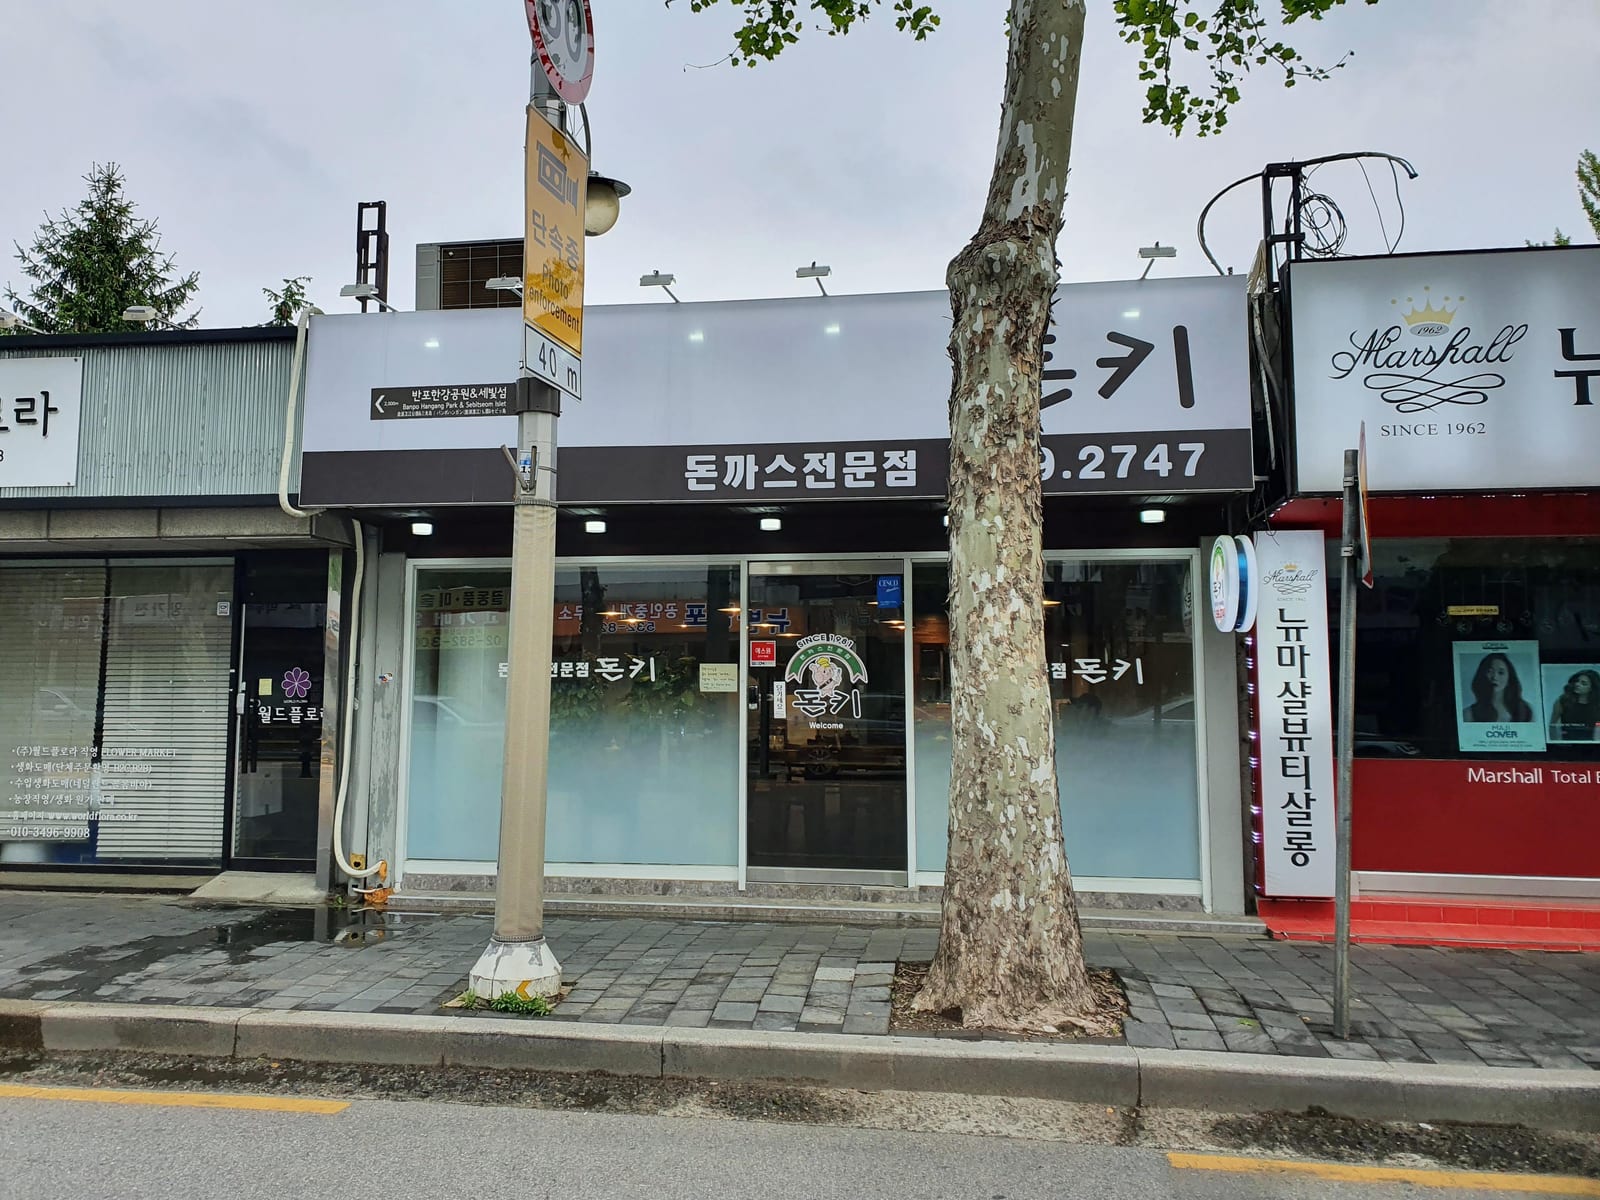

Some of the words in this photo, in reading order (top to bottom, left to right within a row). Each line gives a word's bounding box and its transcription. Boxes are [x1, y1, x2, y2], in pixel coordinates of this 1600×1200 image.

[532, 209, 580, 272] 단속중
[542, 263, 569, 300] Photo
[529, 286, 580, 334] enforcement
[1416, 325, 1443, 335] 1962
[538, 341, 557, 378] 40
[567, 365, 578, 393] m
[1328, 324, 1528, 379] Marshall
[0, 390, 58, 437] 라
[402, 403, 420, 411] Banpo
[420, 402, 445, 411] Hangang
[445, 401, 458, 409] Park
[1380, 423, 1438, 437] SINCE
[1447, 422, 1487, 436] 1962
[684, 449, 917, 491] 돈까스전문점
[797, 634, 827, 648] SINCE
[792, 688, 862, 719] 돈키
[809, 721, 844, 730] Welcome
[1275, 608, 1317, 867] 뉴마샬뷰티살롱
[1486, 730, 1518, 739] COVER
[1467, 767, 1543, 784] Marshall
[1550, 769, 1591, 784] Total
[10, 826, 90, 838] 010-3496-9908
